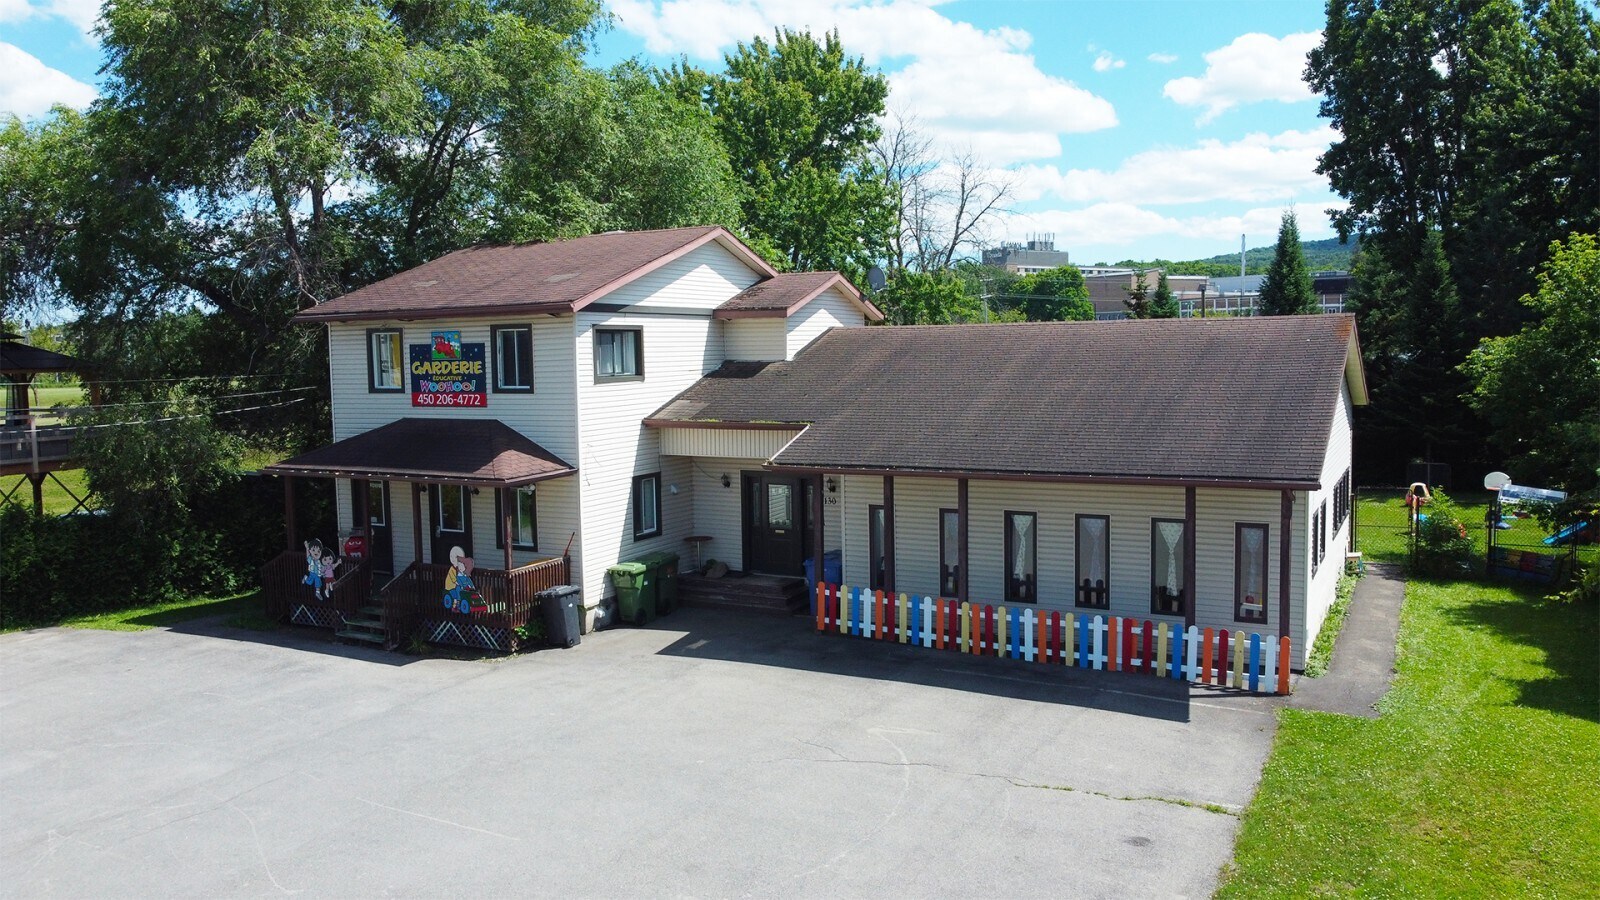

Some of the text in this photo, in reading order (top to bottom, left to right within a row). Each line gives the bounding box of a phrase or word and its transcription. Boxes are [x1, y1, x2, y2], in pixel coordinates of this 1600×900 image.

[411, 361, 482, 375] GARDERIE
[418, 394, 480, 405] 450 206-4772
